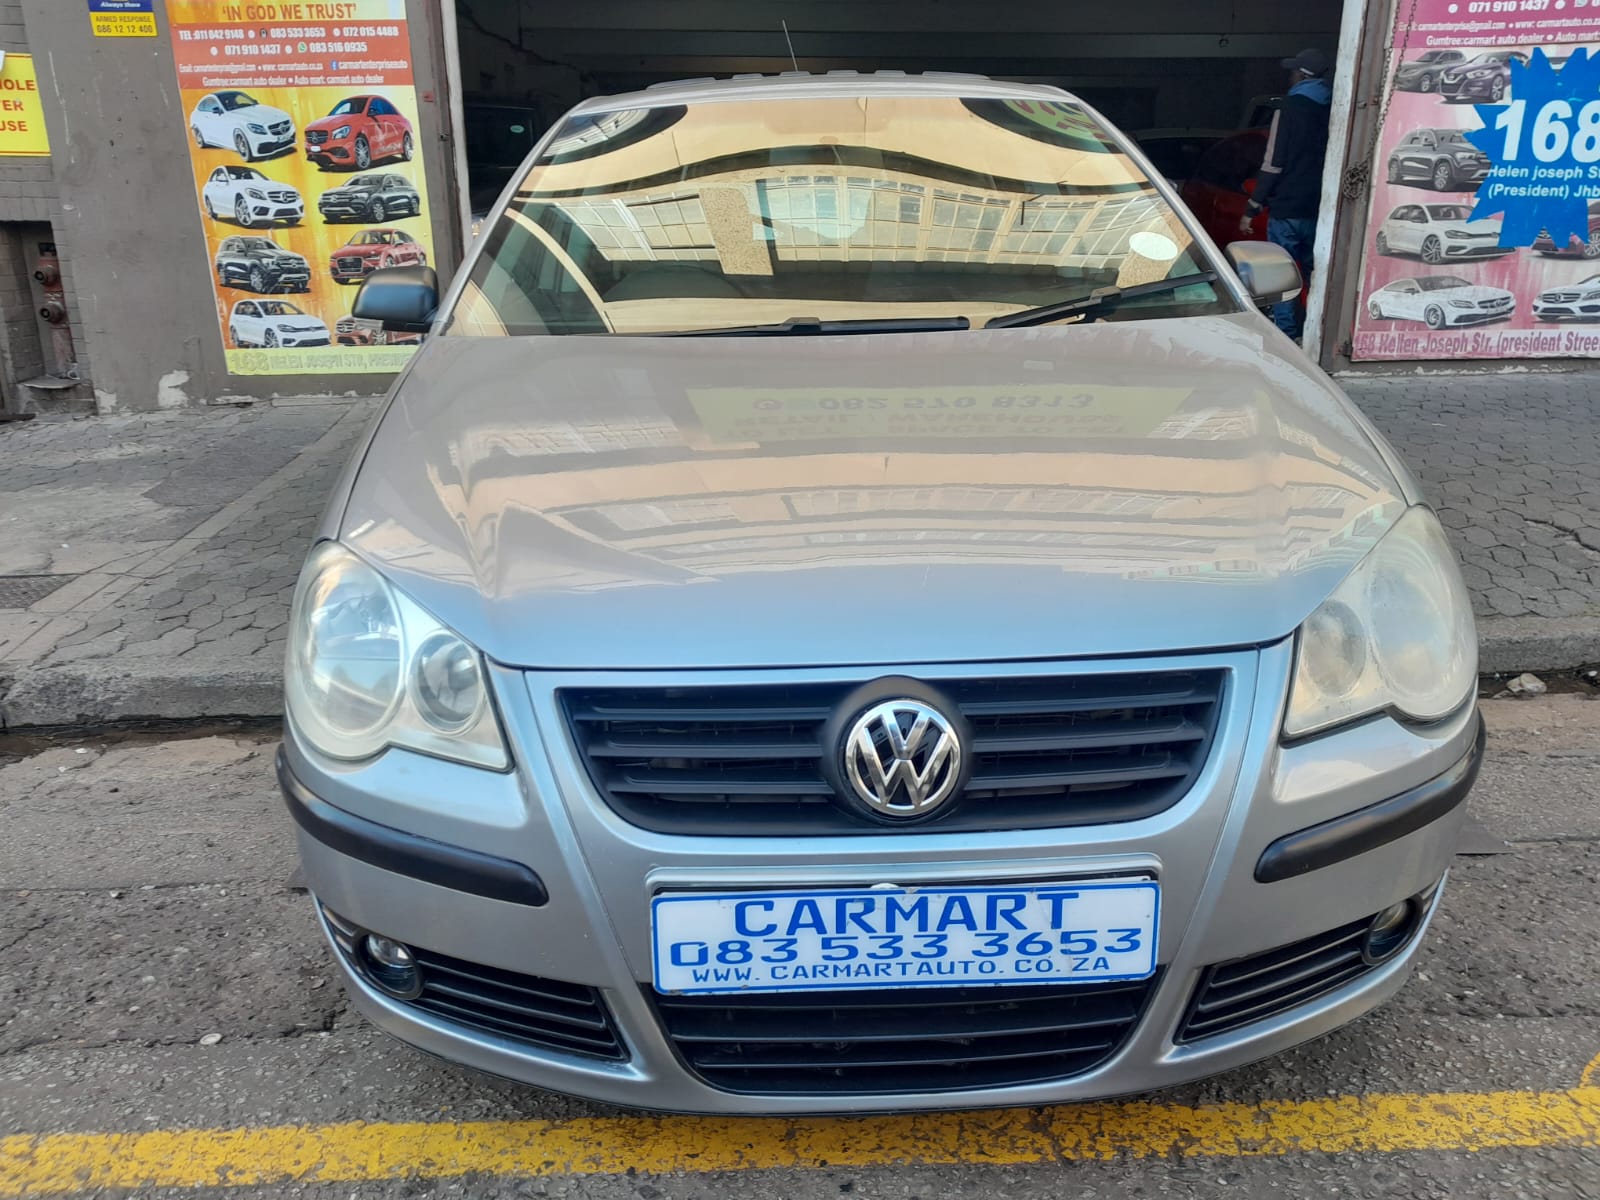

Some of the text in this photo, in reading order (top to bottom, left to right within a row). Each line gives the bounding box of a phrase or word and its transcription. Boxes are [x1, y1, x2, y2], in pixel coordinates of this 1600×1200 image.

[246, 5, 276, 20] GOD
[280, 4, 302, 19] WE
[1468, 0, 1550, 13] 071 910 1437
[115, 25, 123, 33] 12
[127, 25, 136, 33] 12
[225, 45, 240, 55] 071
[1495, 100, 1600, 162] 168
[1488, 165, 1529, 178] Helen
[1532, 165, 1583, 181] joseph
[1488, 184, 1569, 199] (President)
[1423, 331, 1468, 356] Joseph
[1565, 331, 1600, 352] Stree
[734, 892, 1080, 938] CARMART
[670, 928, 1142, 967] 083 533 3653
